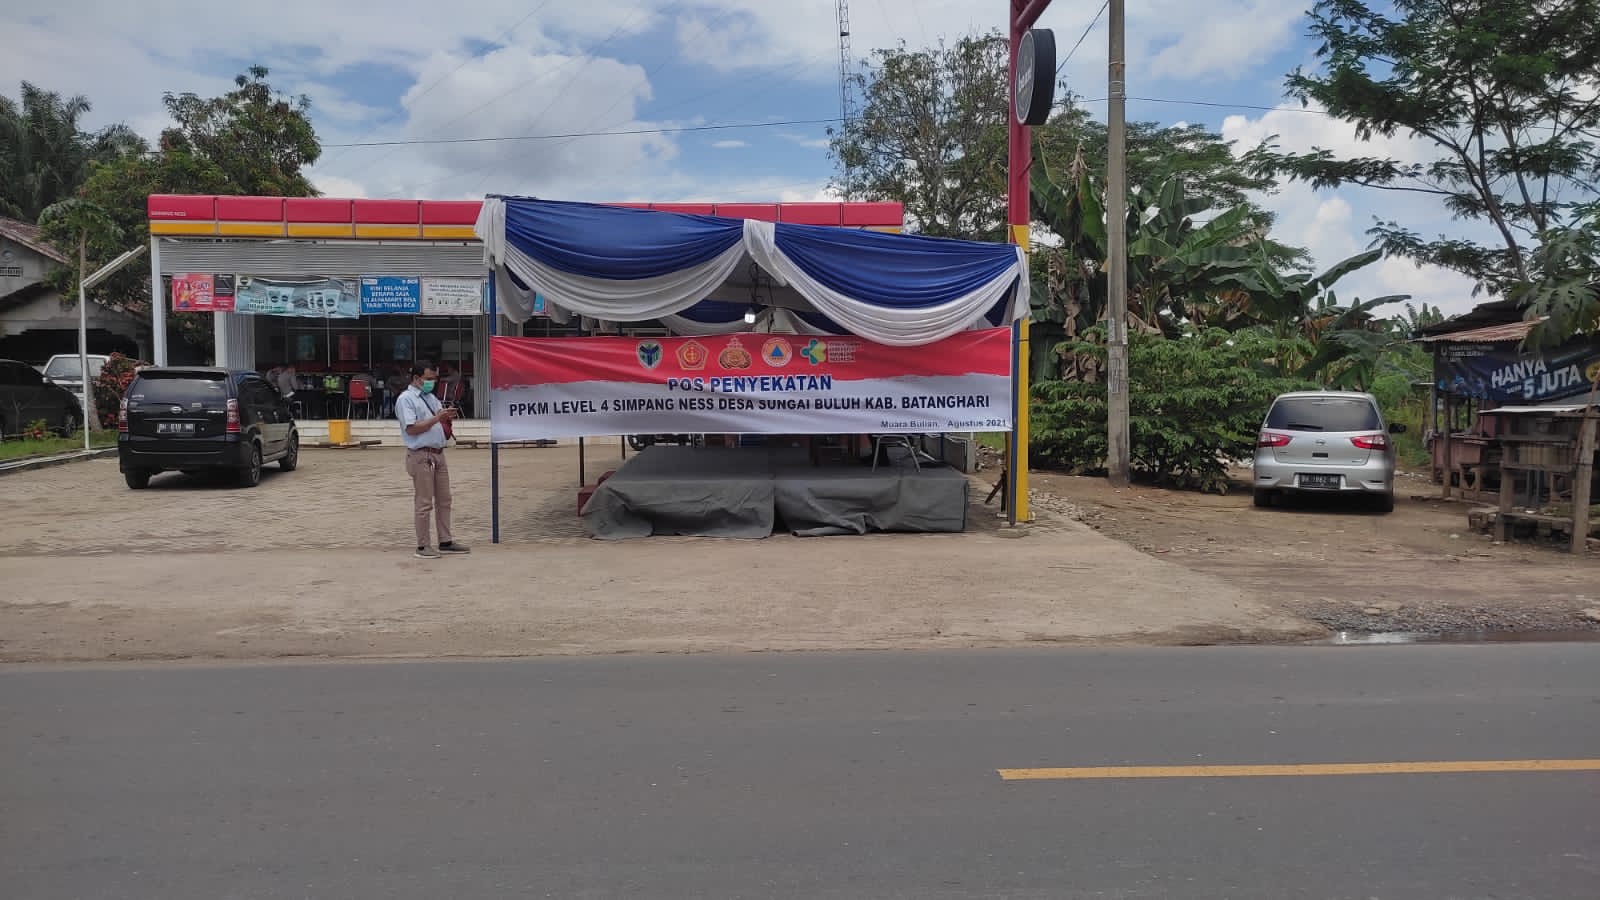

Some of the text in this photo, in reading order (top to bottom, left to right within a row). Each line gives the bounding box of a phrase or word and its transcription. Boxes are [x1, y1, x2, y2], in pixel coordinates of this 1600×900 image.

[668, 374, 832, 393] POS PENYEKATAN
[1491, 359, 1547, 388] HANYA
[1523, 364, 1582, 399] 5 JUTA
[509, 395, 990, 416] PPKM LEVEL 4 SIMPANG NESS DESA SUNGAI BULUH KAB. BATANGHARI
[880, 420, 908, 429] Muara
[947, 419, 984, 429] Agustus
[986, 418, 1007, 427] 2021
